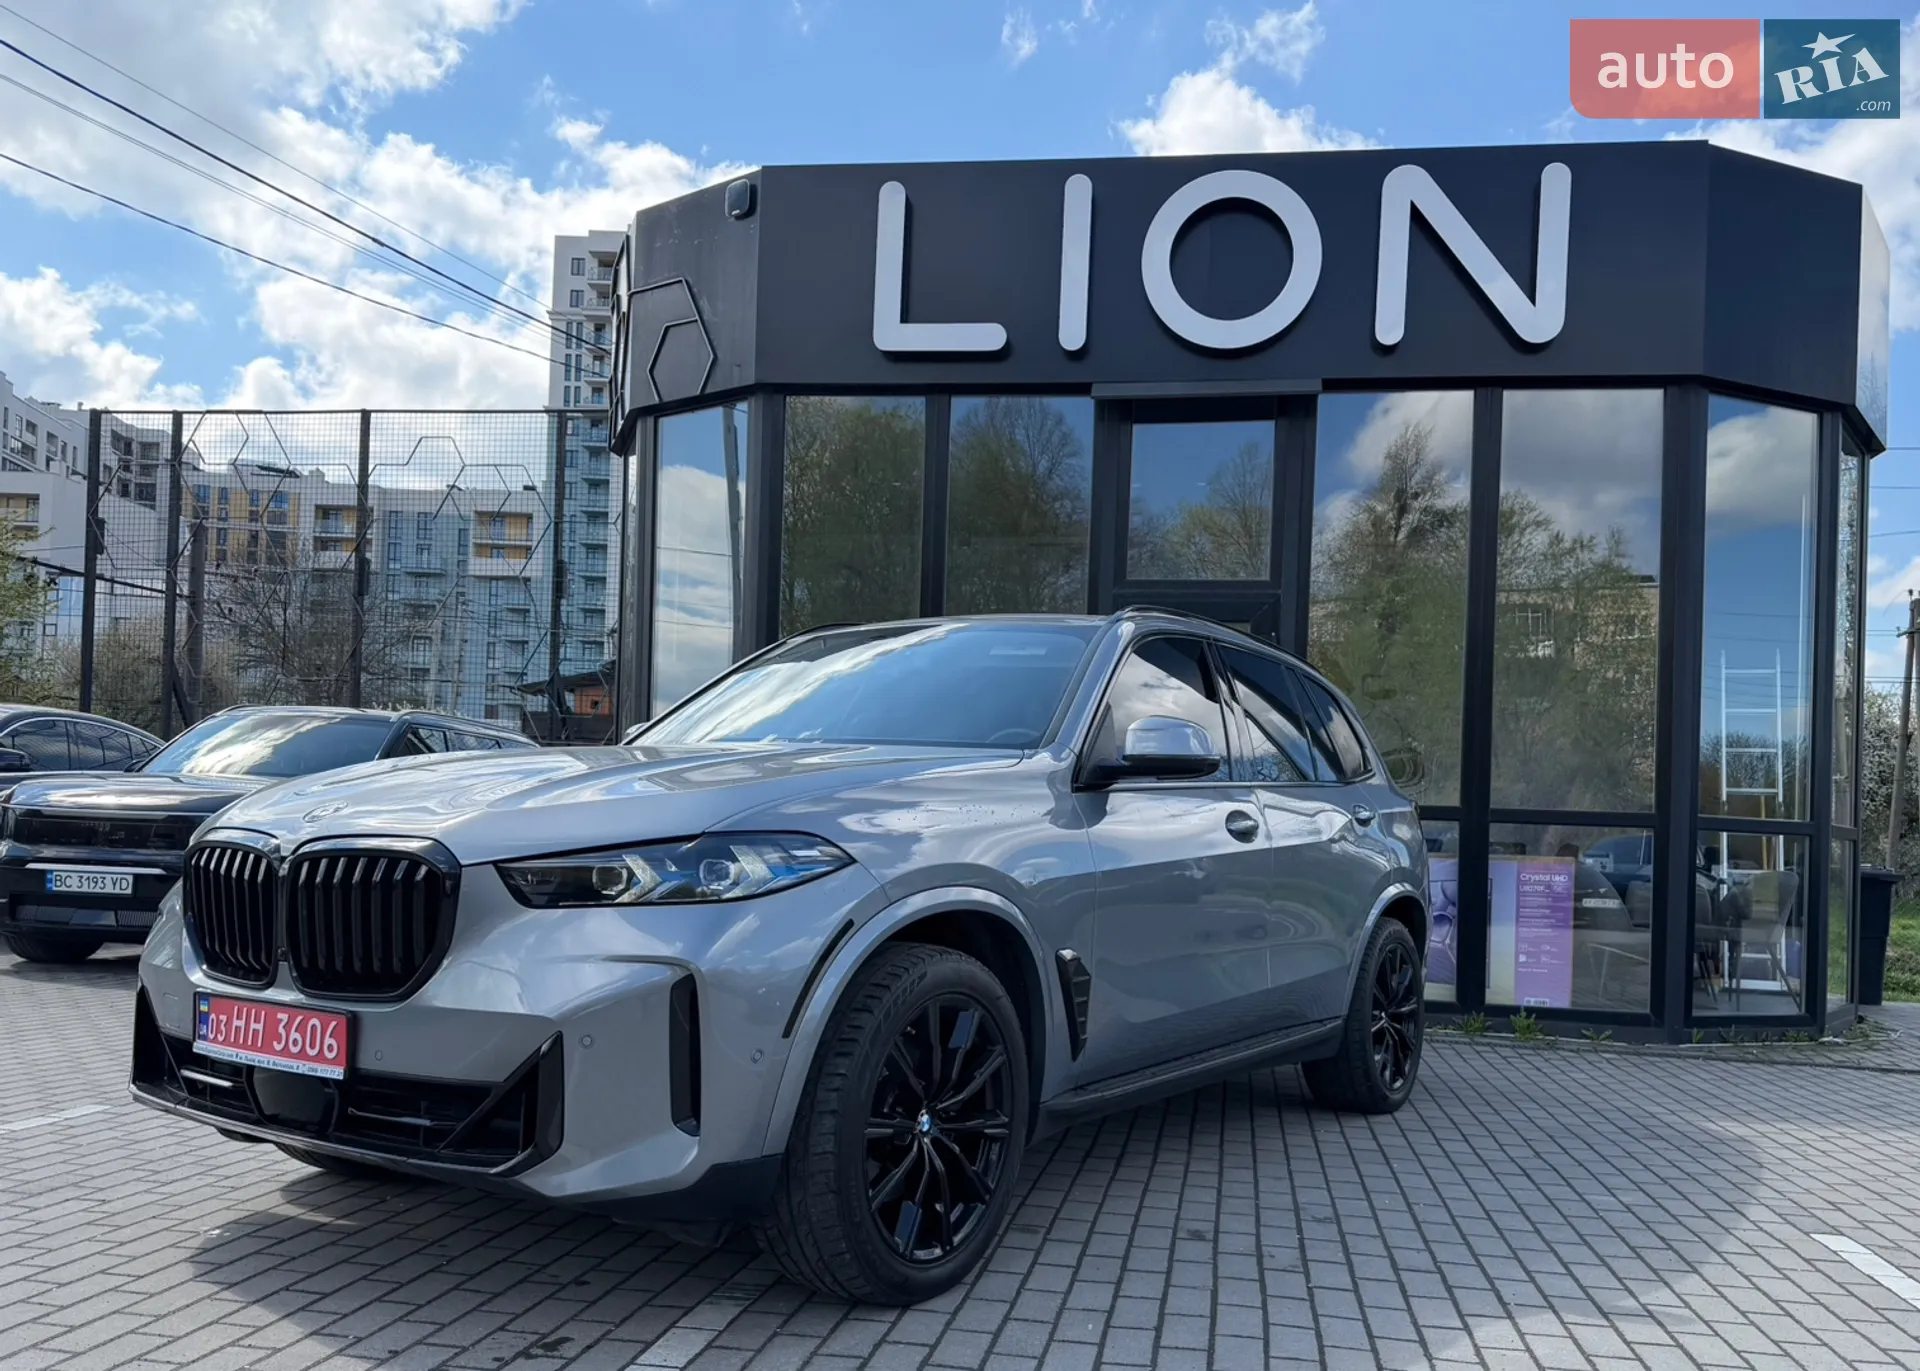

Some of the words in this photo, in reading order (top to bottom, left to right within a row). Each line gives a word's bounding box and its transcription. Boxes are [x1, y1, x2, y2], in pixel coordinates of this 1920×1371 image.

[872, 161, 1572, 352] LION
[54, 874, 72, 889] BC
[77, 875, 106, 890] 3193
[110, 876, 130, 891] YD
[1520, 873, 1550, 884] Crystal
[1551, 874, 1568, 882] UHD
[208, 1012, 228, 1042] 03
[230, 1005, 266, 1048] HH
[272, 1012, 339, 1059] 3606
